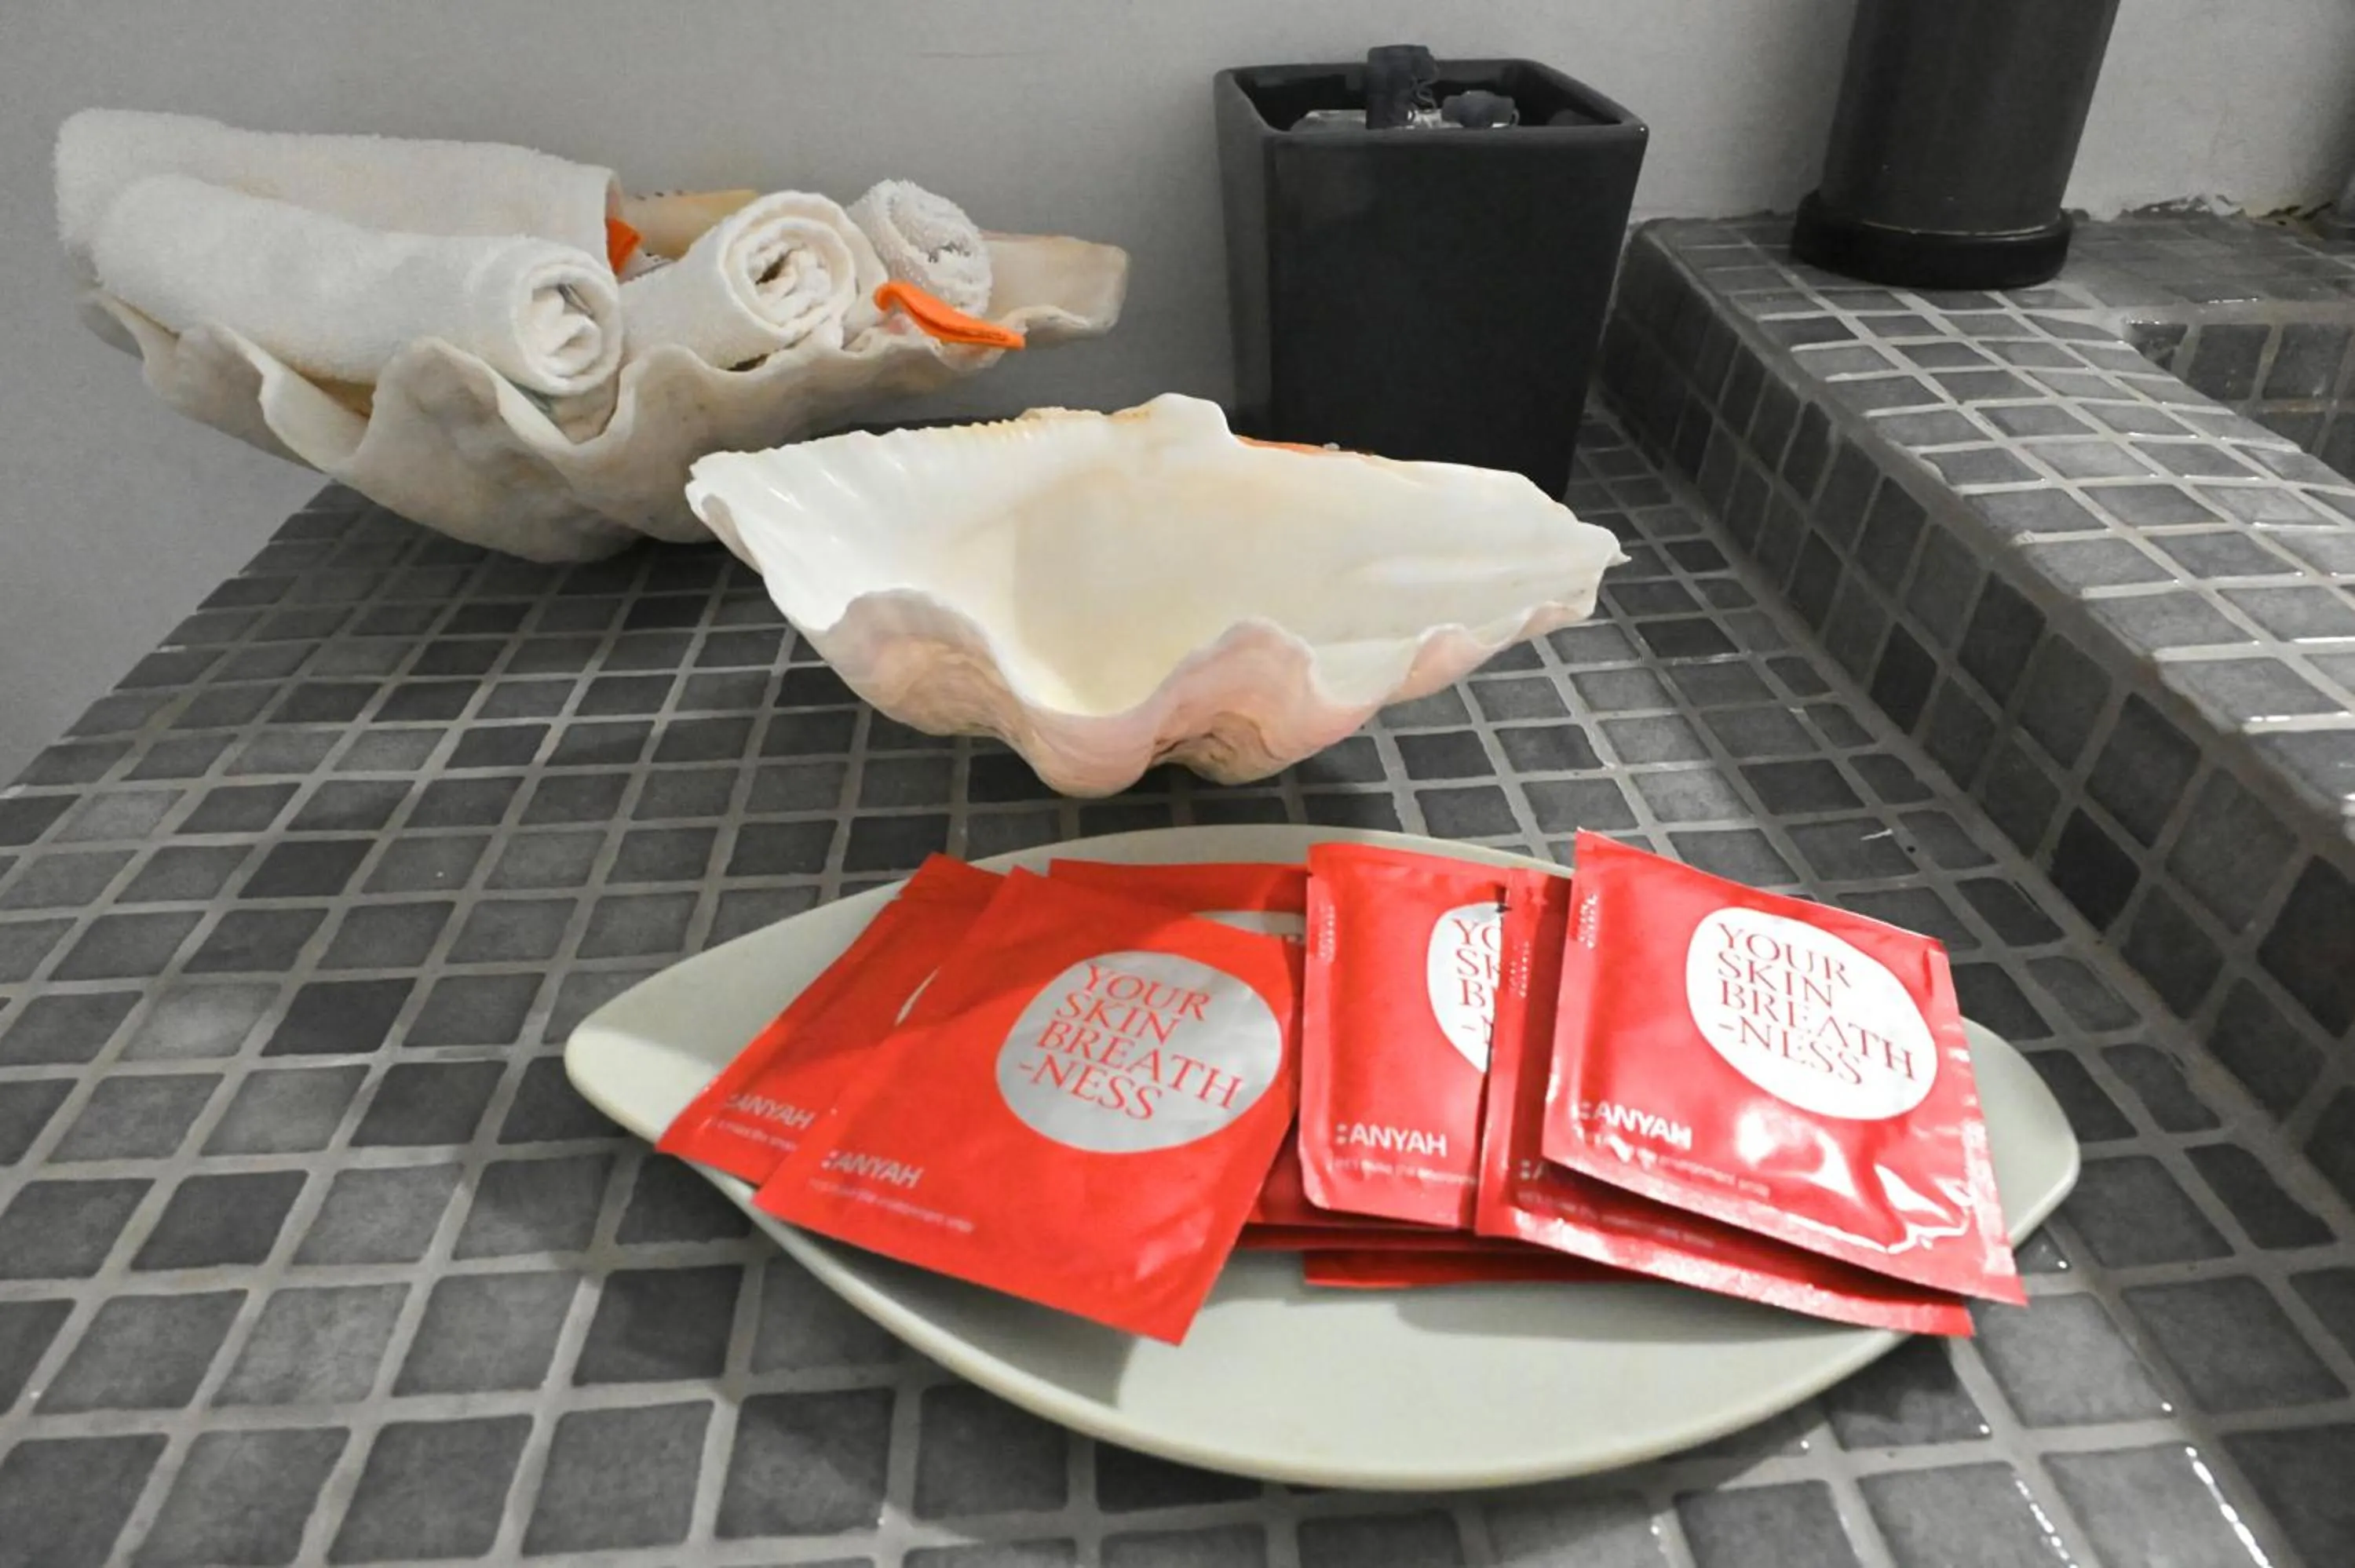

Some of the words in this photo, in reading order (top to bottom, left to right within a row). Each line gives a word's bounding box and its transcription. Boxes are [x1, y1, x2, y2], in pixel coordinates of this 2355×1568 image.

[1451, 917, 1502, 952] YO
[1718, 922, 1851, 989] YOUR
[1079, 964, 1212, 1022] YOUR
[1718, 950, 1833, 1010] SKIN
[1056, 991, 1180, 1045] SKIN
[1720, 979, 1915, 1082] BREATH
[1018, 1053, 1163, 1121] -NESS
[1036, 1019, 1243, 1110] BREATH
